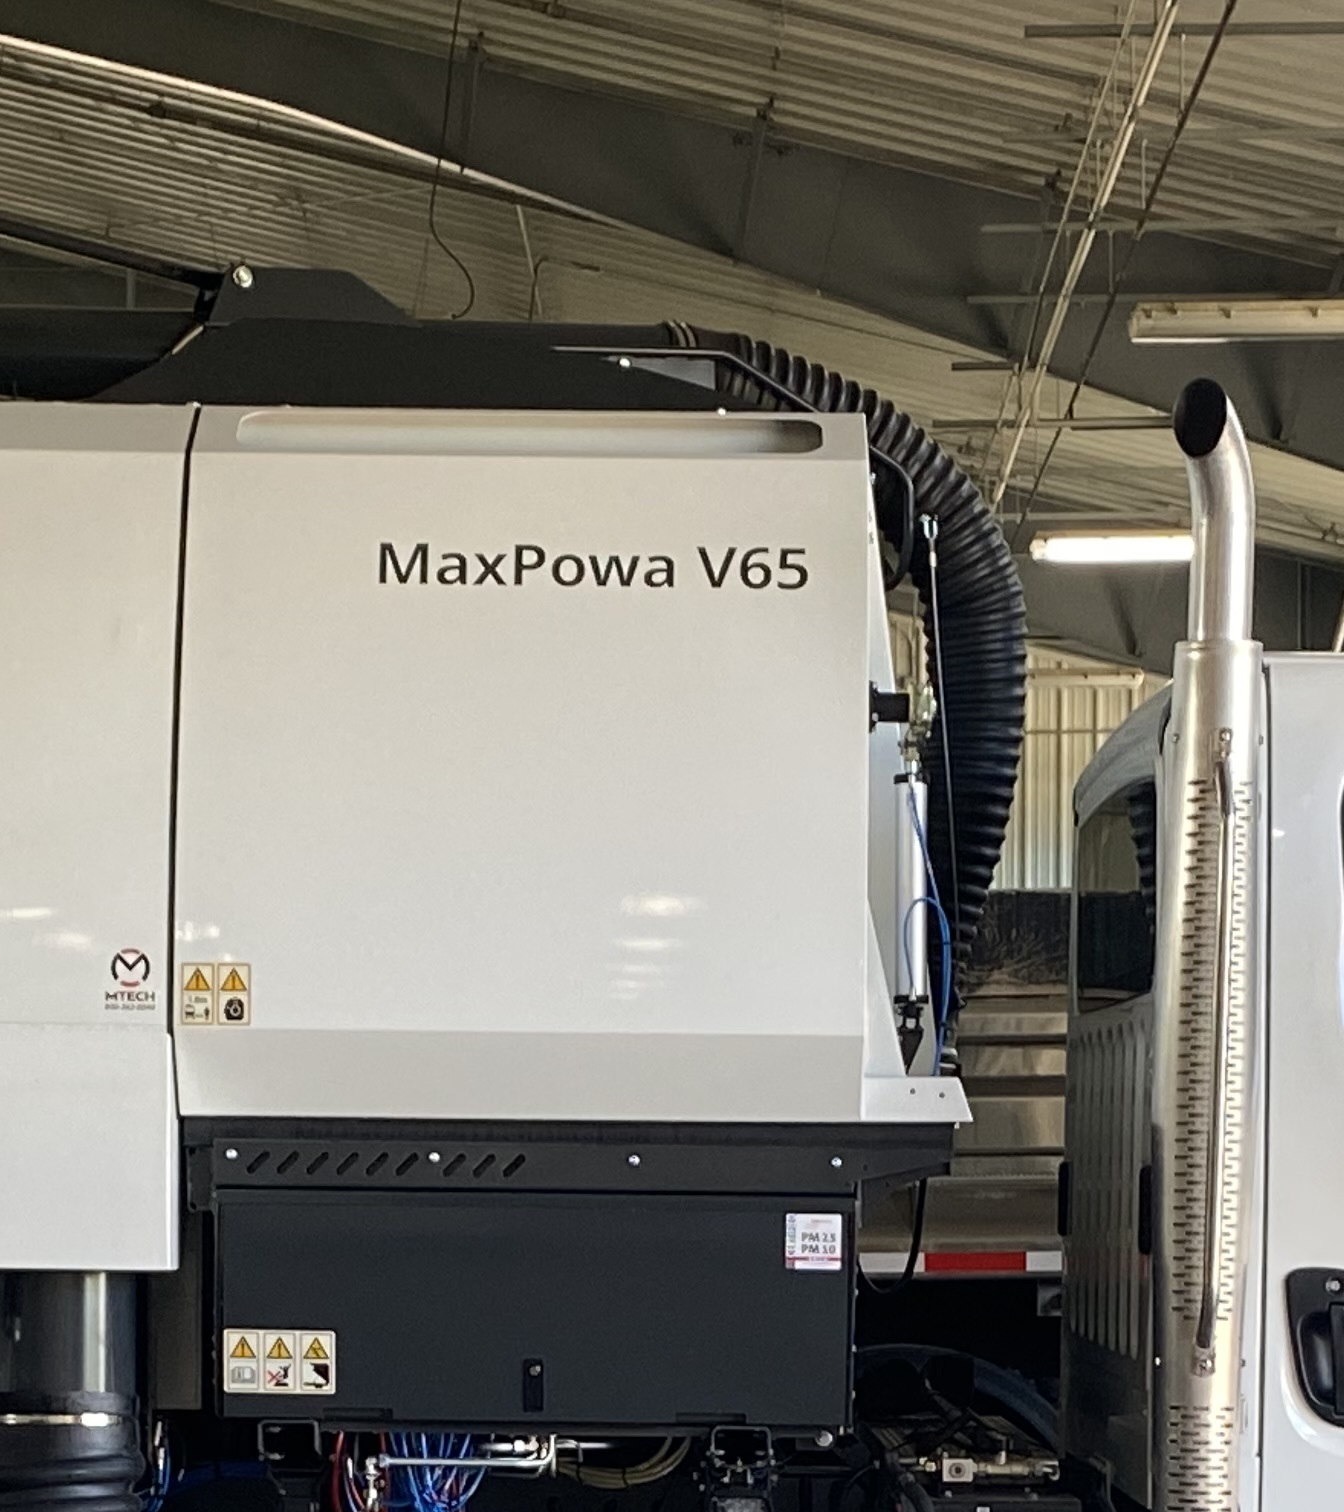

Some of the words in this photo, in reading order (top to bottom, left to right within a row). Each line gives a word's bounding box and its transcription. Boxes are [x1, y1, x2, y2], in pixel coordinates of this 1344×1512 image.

[378, 542, 675, 588] MaxPowa
[697, 546, 809, 590] V65
[105, 991, 155, 1001] MTECH
